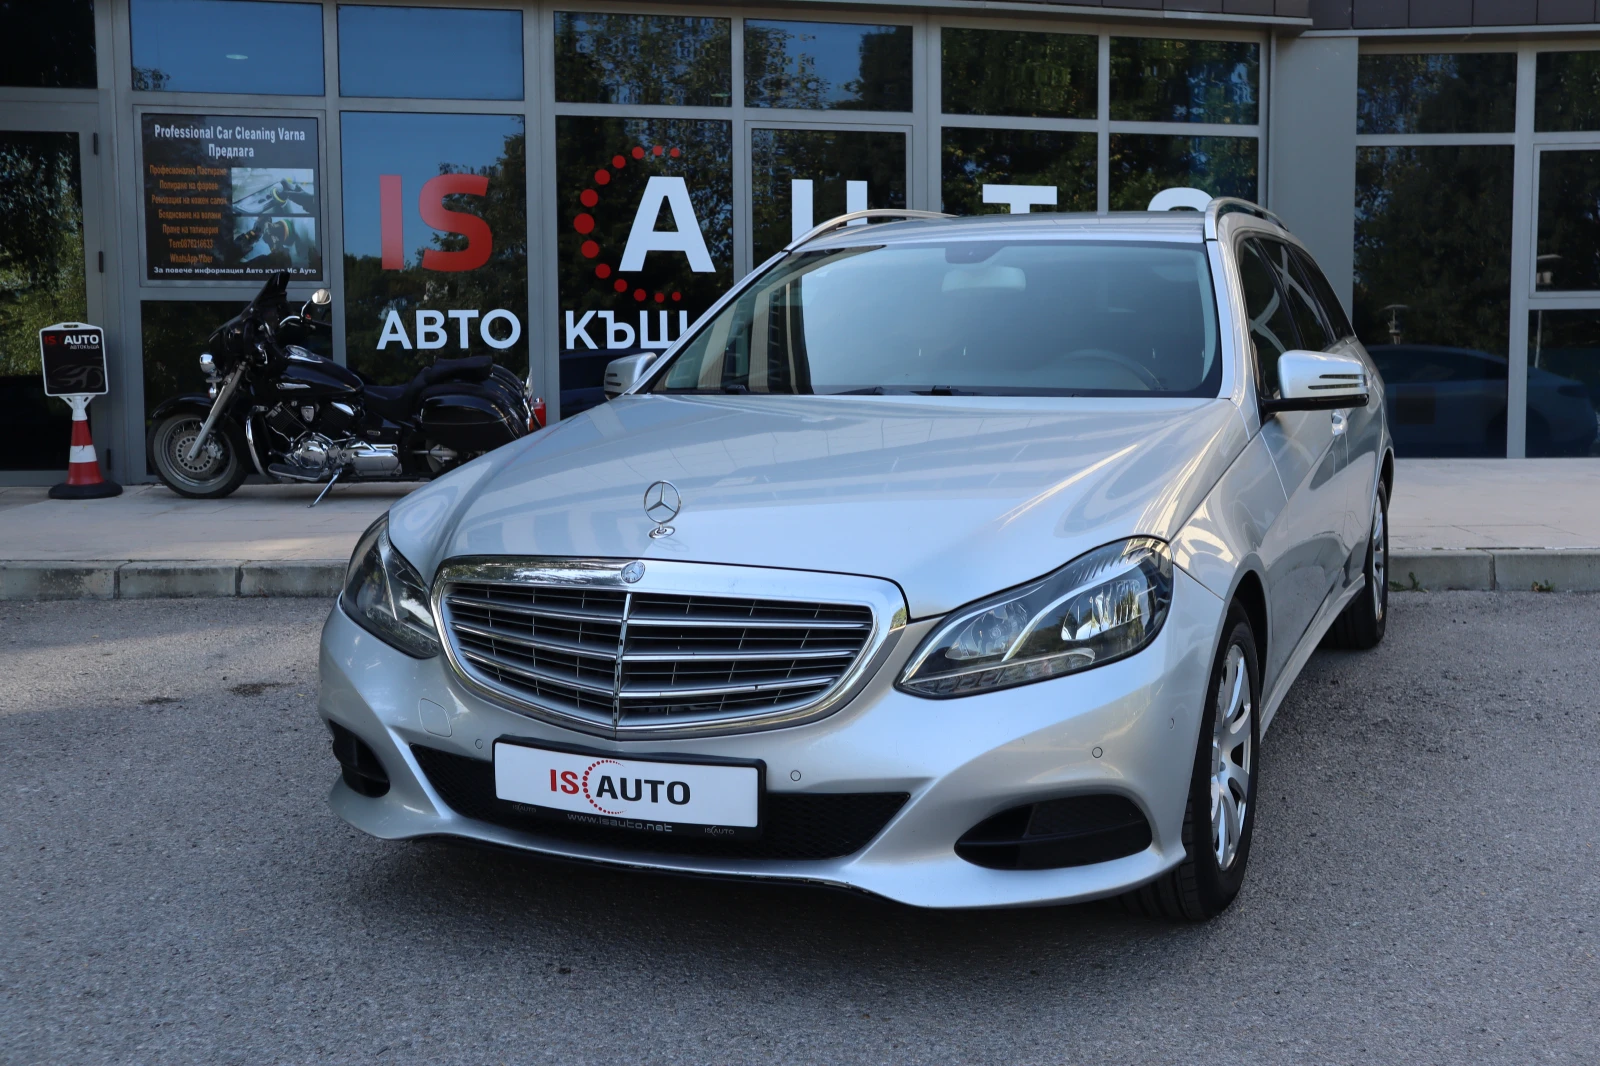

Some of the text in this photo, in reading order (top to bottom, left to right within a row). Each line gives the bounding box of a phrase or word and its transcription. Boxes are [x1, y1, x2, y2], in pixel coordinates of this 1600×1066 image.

[154, 124, 306, 143] Professional Car Cleaning Varna
[208, 143, 255, 160] Предлага
[188, 182, 196, 190] на
[182, 197, 190, 205] на
[192, 211, 200, 219] на
[379, 173, 493, 272] IS
[181, 226, 189, 234] на
[153, 266, 163, 274] За
[194, 267, 244, 275] информация
[299, 267, 317, 275] Ауто
[376, 308, 522, 350] АВТО
[64, 334, 99, 345] AUTO
[550, 769, 691, 806] IS AUTO
[566, 813, 673, 833] www.isauto.net
